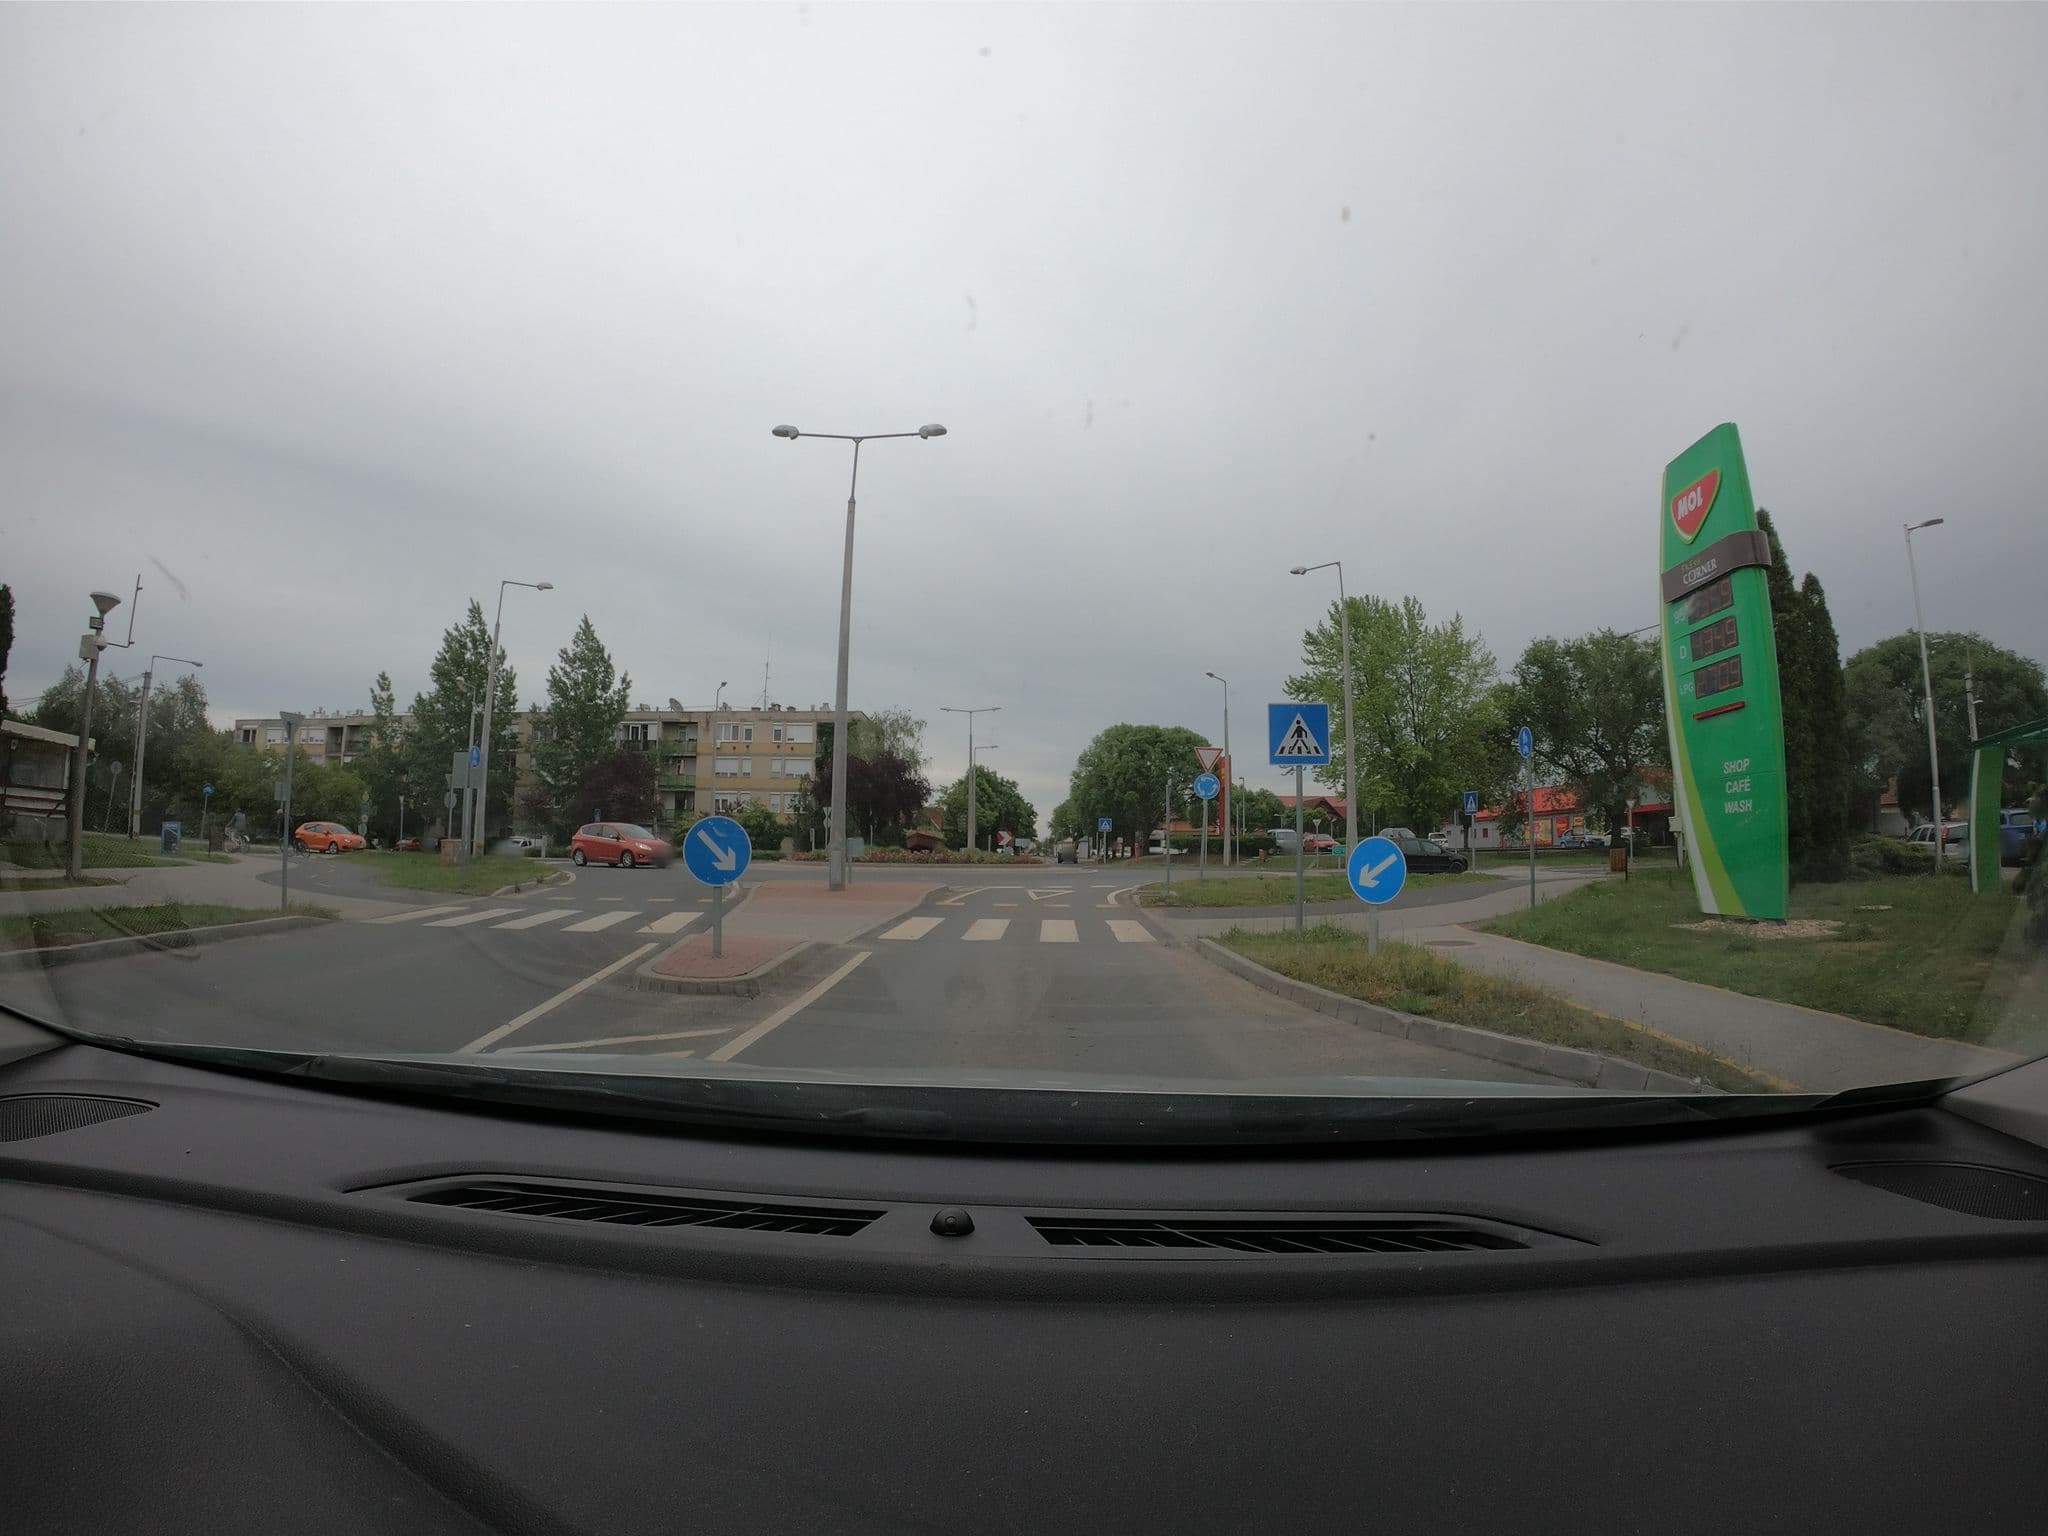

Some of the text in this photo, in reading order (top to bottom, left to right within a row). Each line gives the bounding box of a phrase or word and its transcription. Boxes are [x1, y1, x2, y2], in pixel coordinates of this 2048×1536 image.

[1677, 486, 1703, 521] MOL
[1683, 558, 1718, 584] CORNER
[1723, 758, 1750, 775] SHOP
[1726, 776, 1751, 793] CAFÉ
[1724, 799, 1752, 814] WASH
